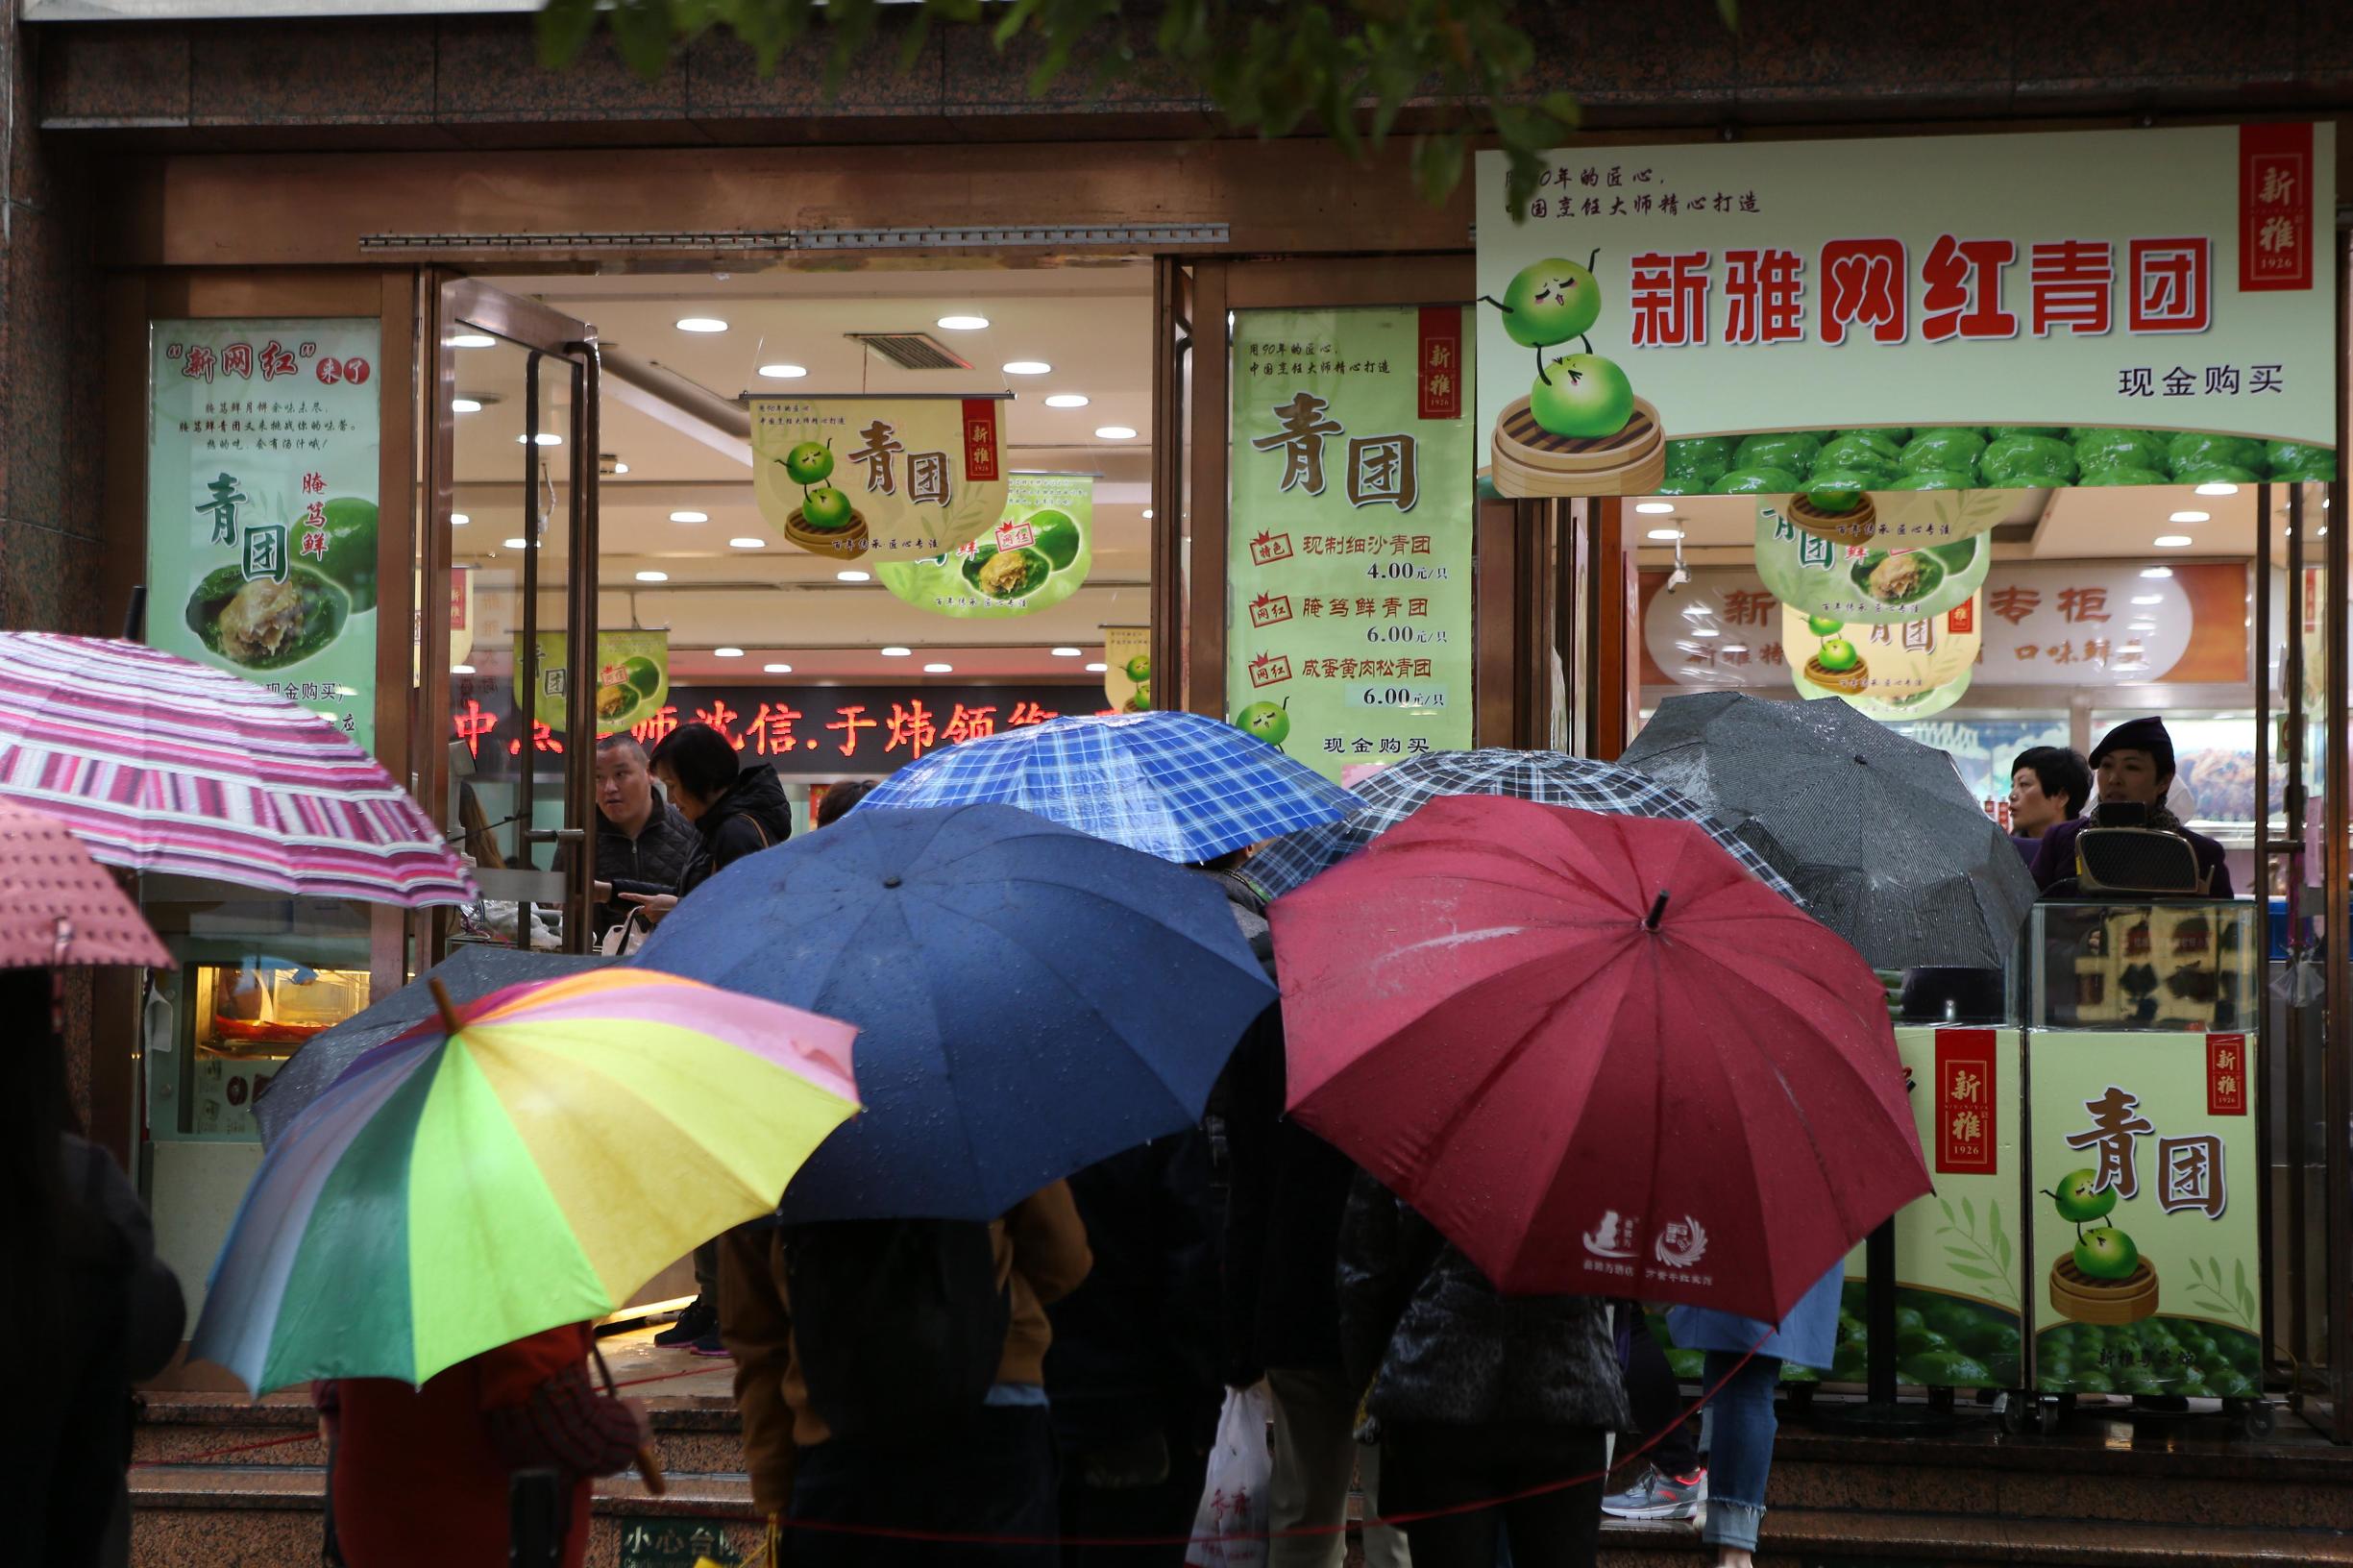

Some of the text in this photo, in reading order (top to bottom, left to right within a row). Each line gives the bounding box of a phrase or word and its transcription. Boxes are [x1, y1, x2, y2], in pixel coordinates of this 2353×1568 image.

[1505, 165, 1666, 188] 0年的匠心，
[2259, 166, 2294, 253] 新雅
[2261, 258, 2292, 269] 1926
[1630, 234, 2211, 347] 新雅网红青团
[319, 358, 365, 384] 来了
[1249, 359, 1391, 376] 中国烹饪大师精心打造
[1430, 345, 1451, 397] 新雅
[2118, 364, 2284, 397] 现金购买
[847, 419, 952, 507] 青团
[971, 425, 991, 464] 新雅
[1252, 391, 1418, 512] 青团
[194, 471, 289, 584] 青团
[302, 472, 329, 561] 腌笃鲜
[1259, 535, 1431, 558] 特色 现制细沙青团
[1257, 597, 1429, 620] 网红 腌笃鲜青团
[1724, 585, 2112, 627] 新 专柜
[1257, 658, 1432, 680] 网红 咸蛋黄肉松青团
[1323, 737, 1430, 753] 现金购买
[2216, 1049, 2237, 1095] 新雅
[1950, 1069, 1982, 1142] 新雅
[1953, 1145, 1979, 1155] 1926
[2066, 1086, 2227, 1219] 青团
